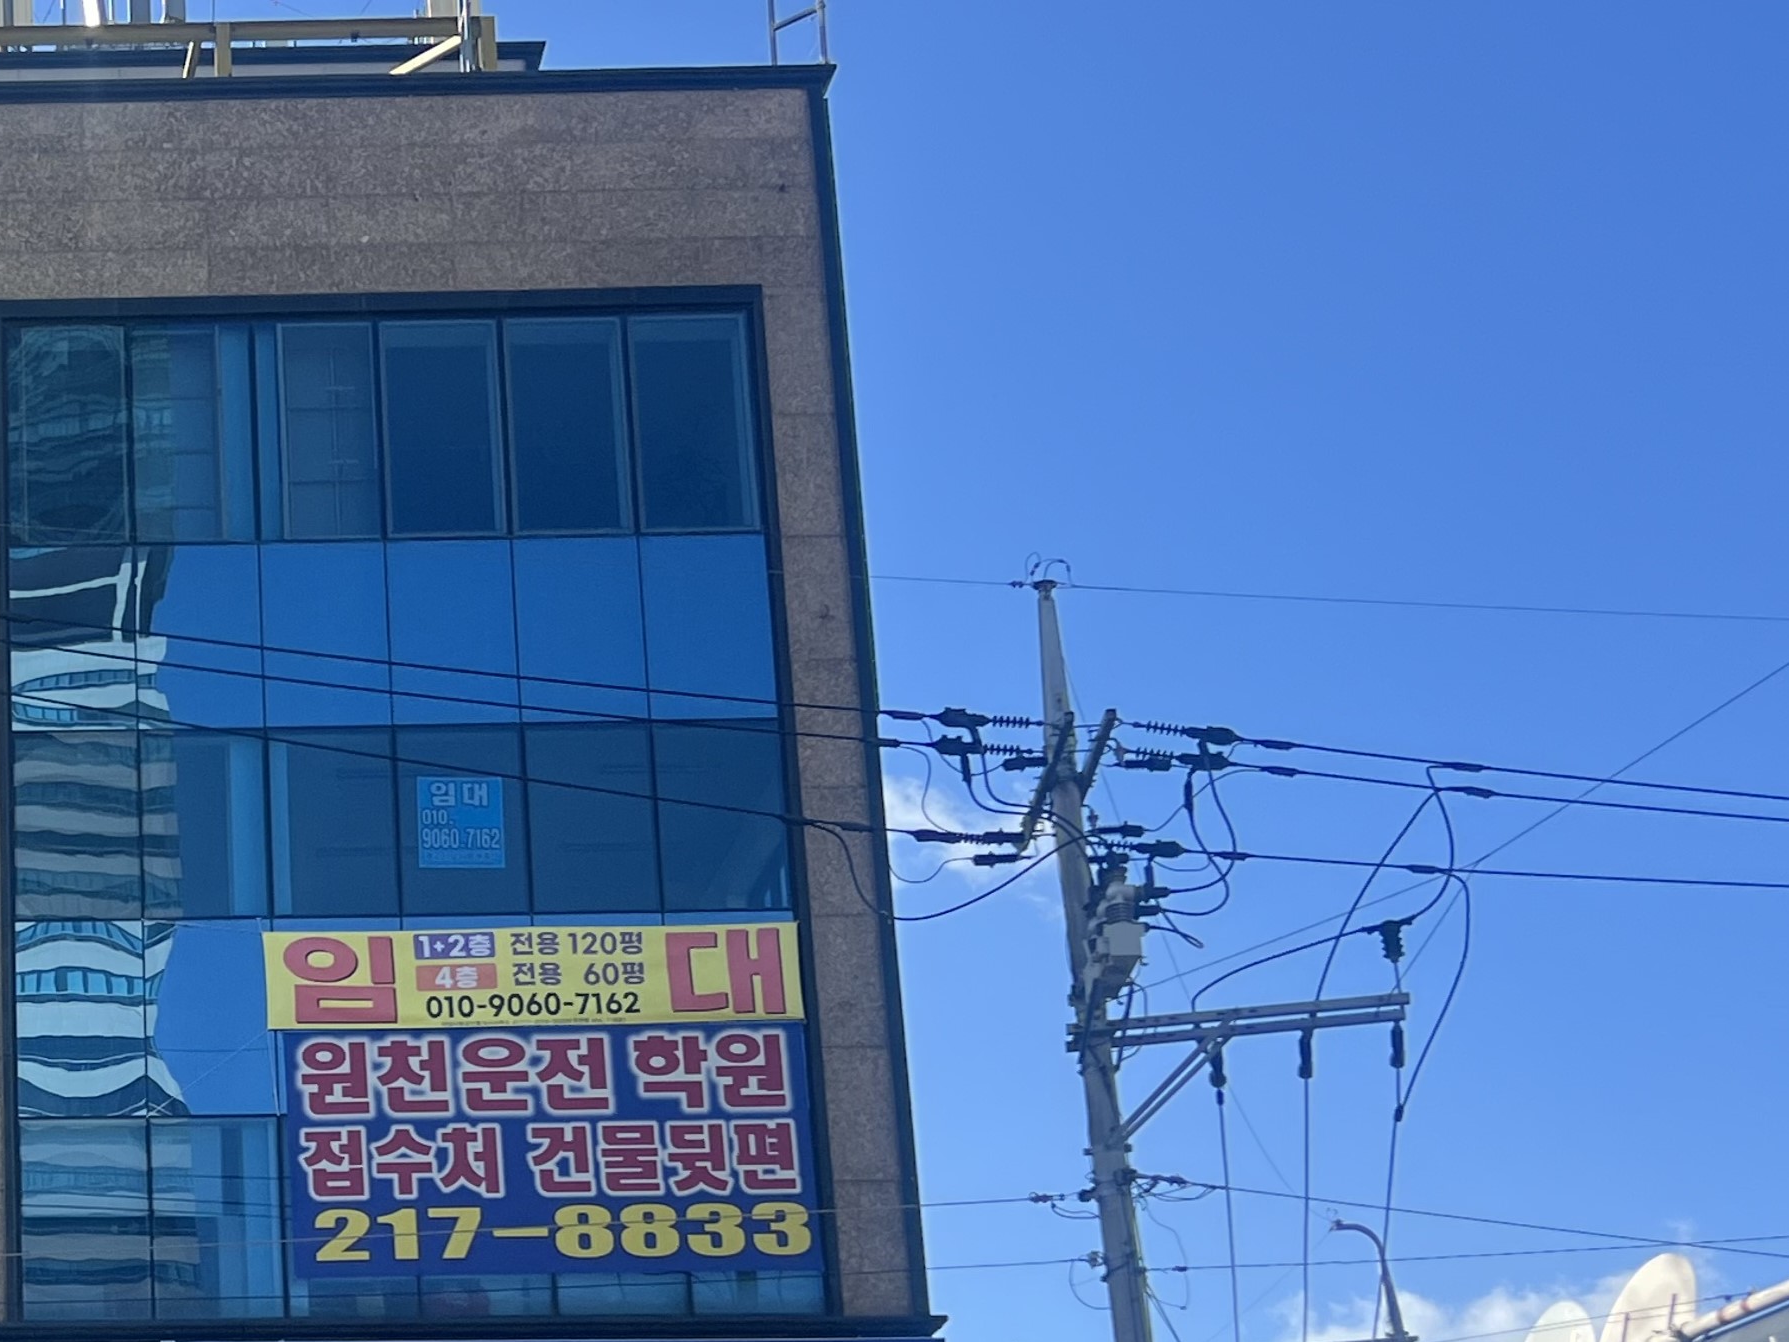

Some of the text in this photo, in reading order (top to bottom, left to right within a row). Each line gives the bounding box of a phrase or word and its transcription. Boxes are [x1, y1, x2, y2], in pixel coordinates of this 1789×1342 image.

[417, 931, 644, 959] 1+2층 전용 120평
[434, 961, 645, 989] 4층 전용 60평
[425, 991, 641, 1019] 010-9060-7162
[299, 1033, 788, 1116] 원천운전 학원
[301, 1121, 800, 1197] 접수처 건물뒷편
[314, 1202, 813, 1262] 217-8833
